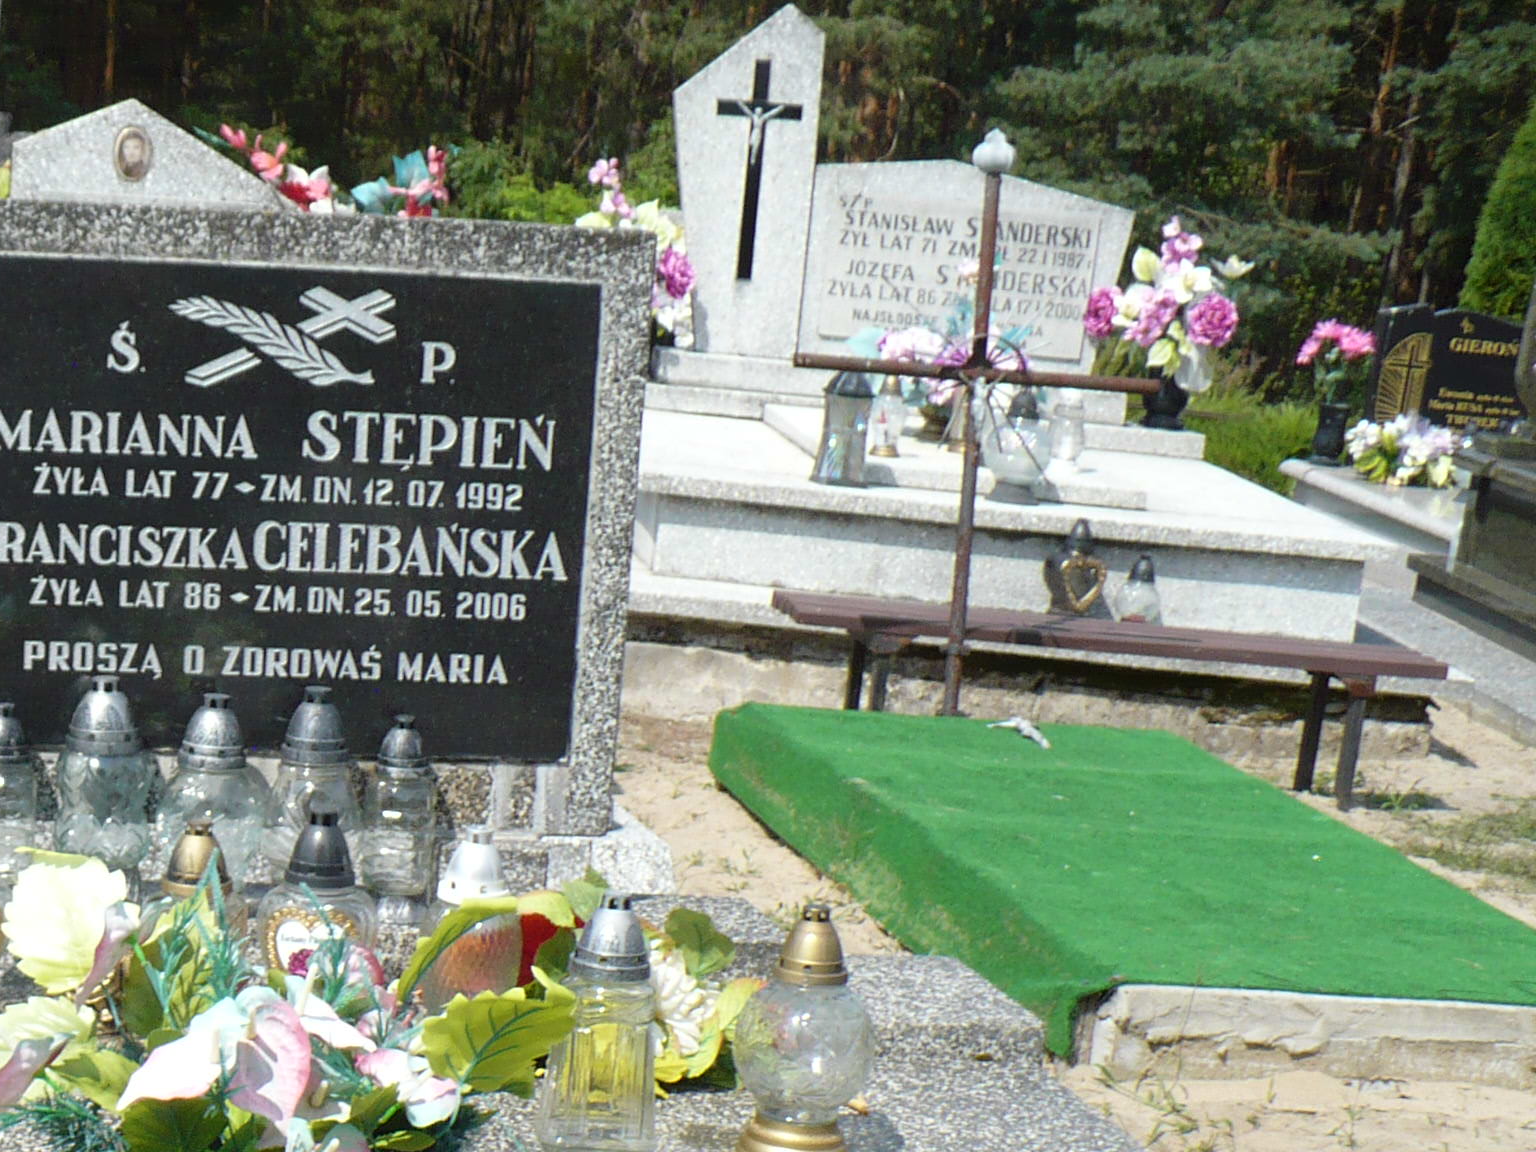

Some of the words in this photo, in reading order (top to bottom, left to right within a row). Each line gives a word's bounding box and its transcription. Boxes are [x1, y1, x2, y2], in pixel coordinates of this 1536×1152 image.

[845, 209, 954, 236] STANISŁAW
[966, 217, 1091, 249] SANDERSKI
[880, 234, 912, 250] LAT
[878, 284, 912, 303] LAT
[302, 410, 556, 472] STĘPIEŃ
[33, 462, 110, 497] ŻYŁA
[125, 469, 177, 499] LAT
[192, 471, 230, 499] 77
[252, 520, 568, 581] CELEBAŃSKA
[29, 574, 104, 607] ŻYŁA
[119, 580, 170, 609] LAT
[183, 582, 222, 610] 86
[23, 640, 163, 680] PROSZĄ
[183, 644, 205, 675] O
[221, 644, 382, 681] ZDROWAŚ
[397, 652, 509, 685] MARIA
